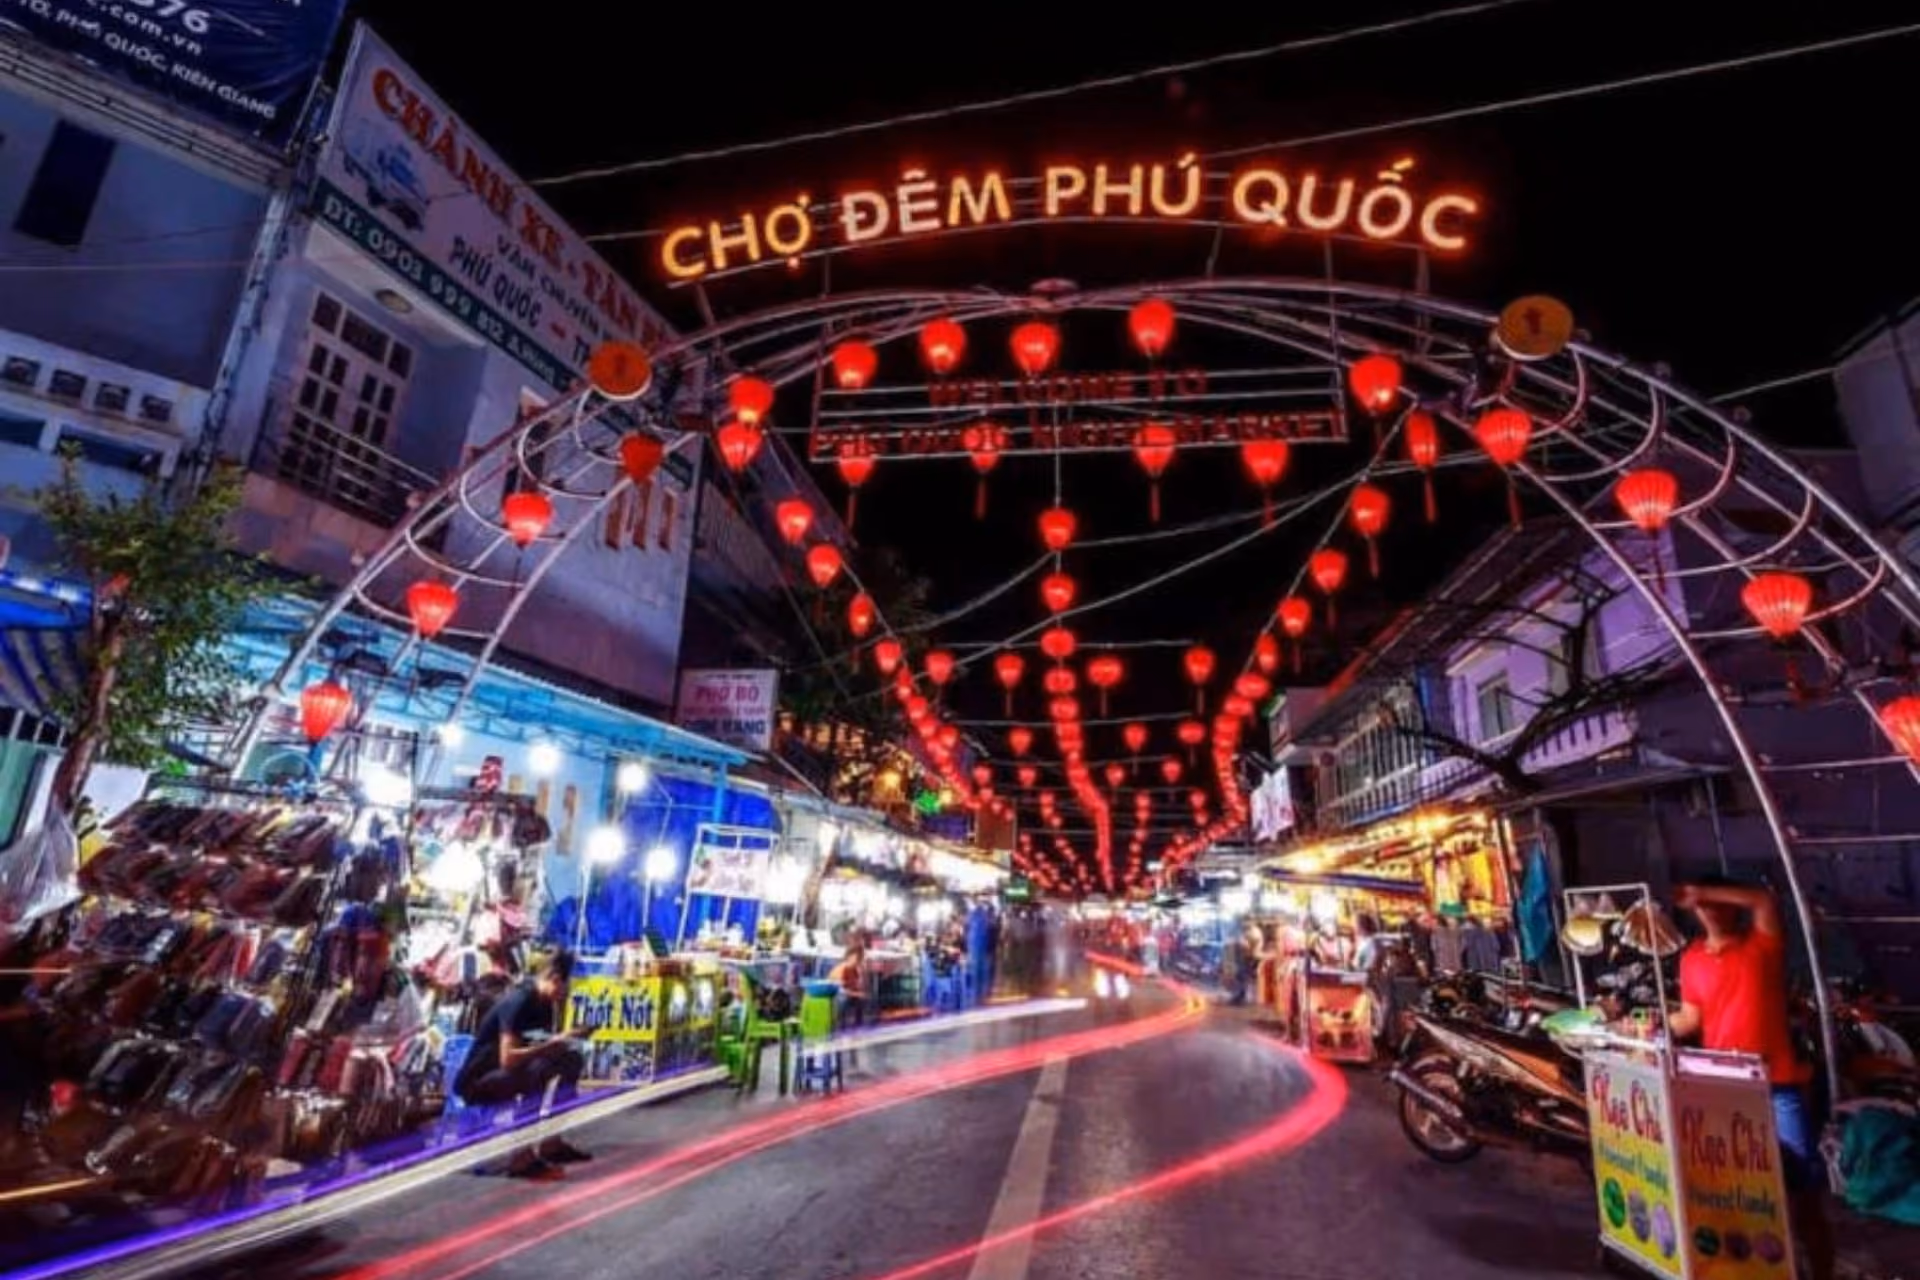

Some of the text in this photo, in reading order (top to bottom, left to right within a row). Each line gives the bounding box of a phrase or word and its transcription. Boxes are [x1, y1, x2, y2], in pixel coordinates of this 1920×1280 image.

[129, 0, 210, 34] 76
[661, 152, 1478, 278] CHỢ ĐÊM PHÚ QUỐC
[368, 229, 424, 283] 0903
[448, 234, 492, 287] PHÚ
[494, 272, 543, 328] QUỐC
